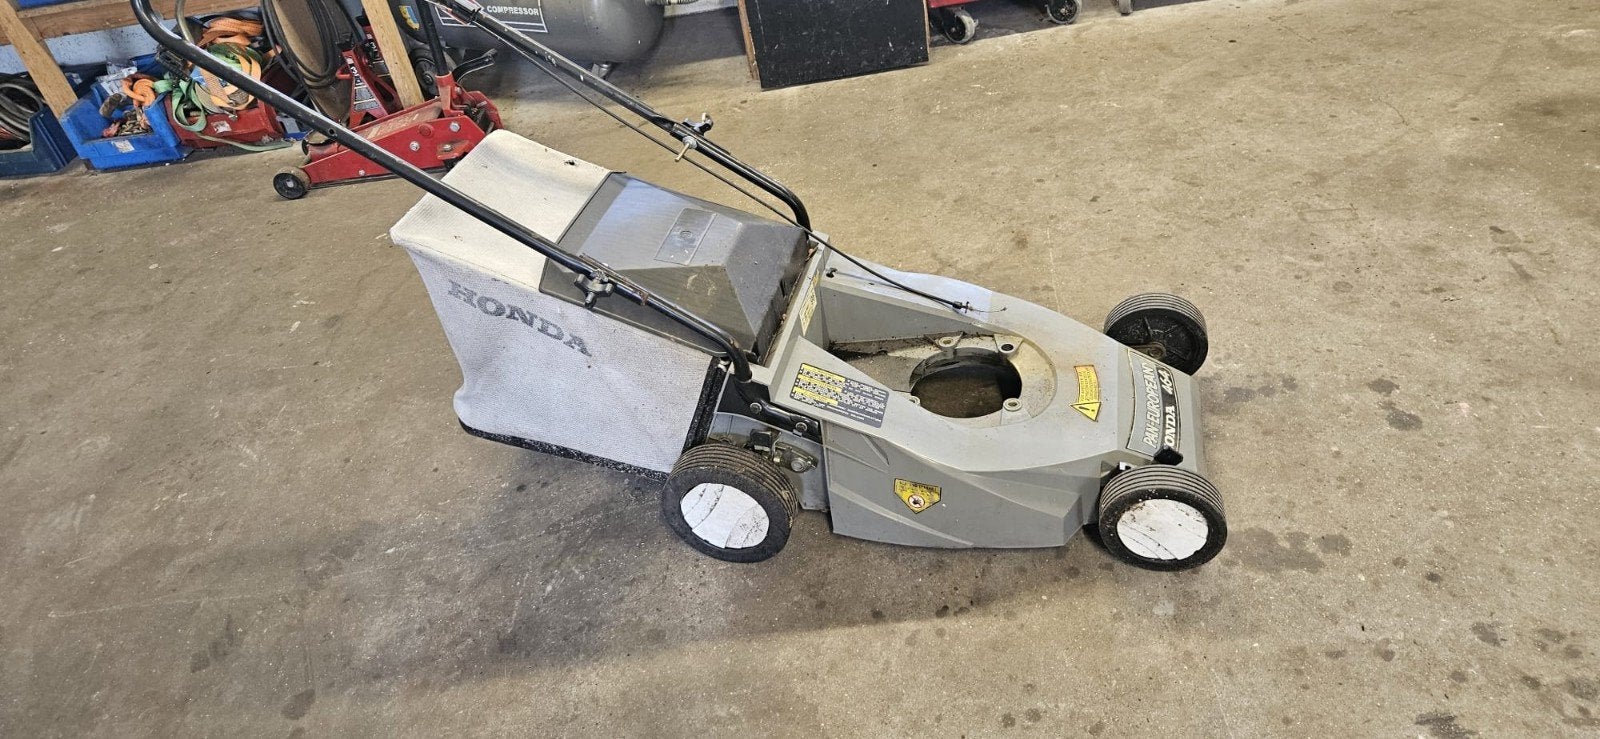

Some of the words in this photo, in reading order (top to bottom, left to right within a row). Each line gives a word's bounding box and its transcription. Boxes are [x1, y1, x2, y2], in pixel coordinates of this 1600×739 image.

[486, 5, 540, 16] COMPRESSOR
[448, 280, 592, 357] HONDA
[1160, 369, 1173, 395] 464
[1142, 363, 1161, 448] PAN-EUROPEAN
[1164, 405, 1176, 449] ONDA
